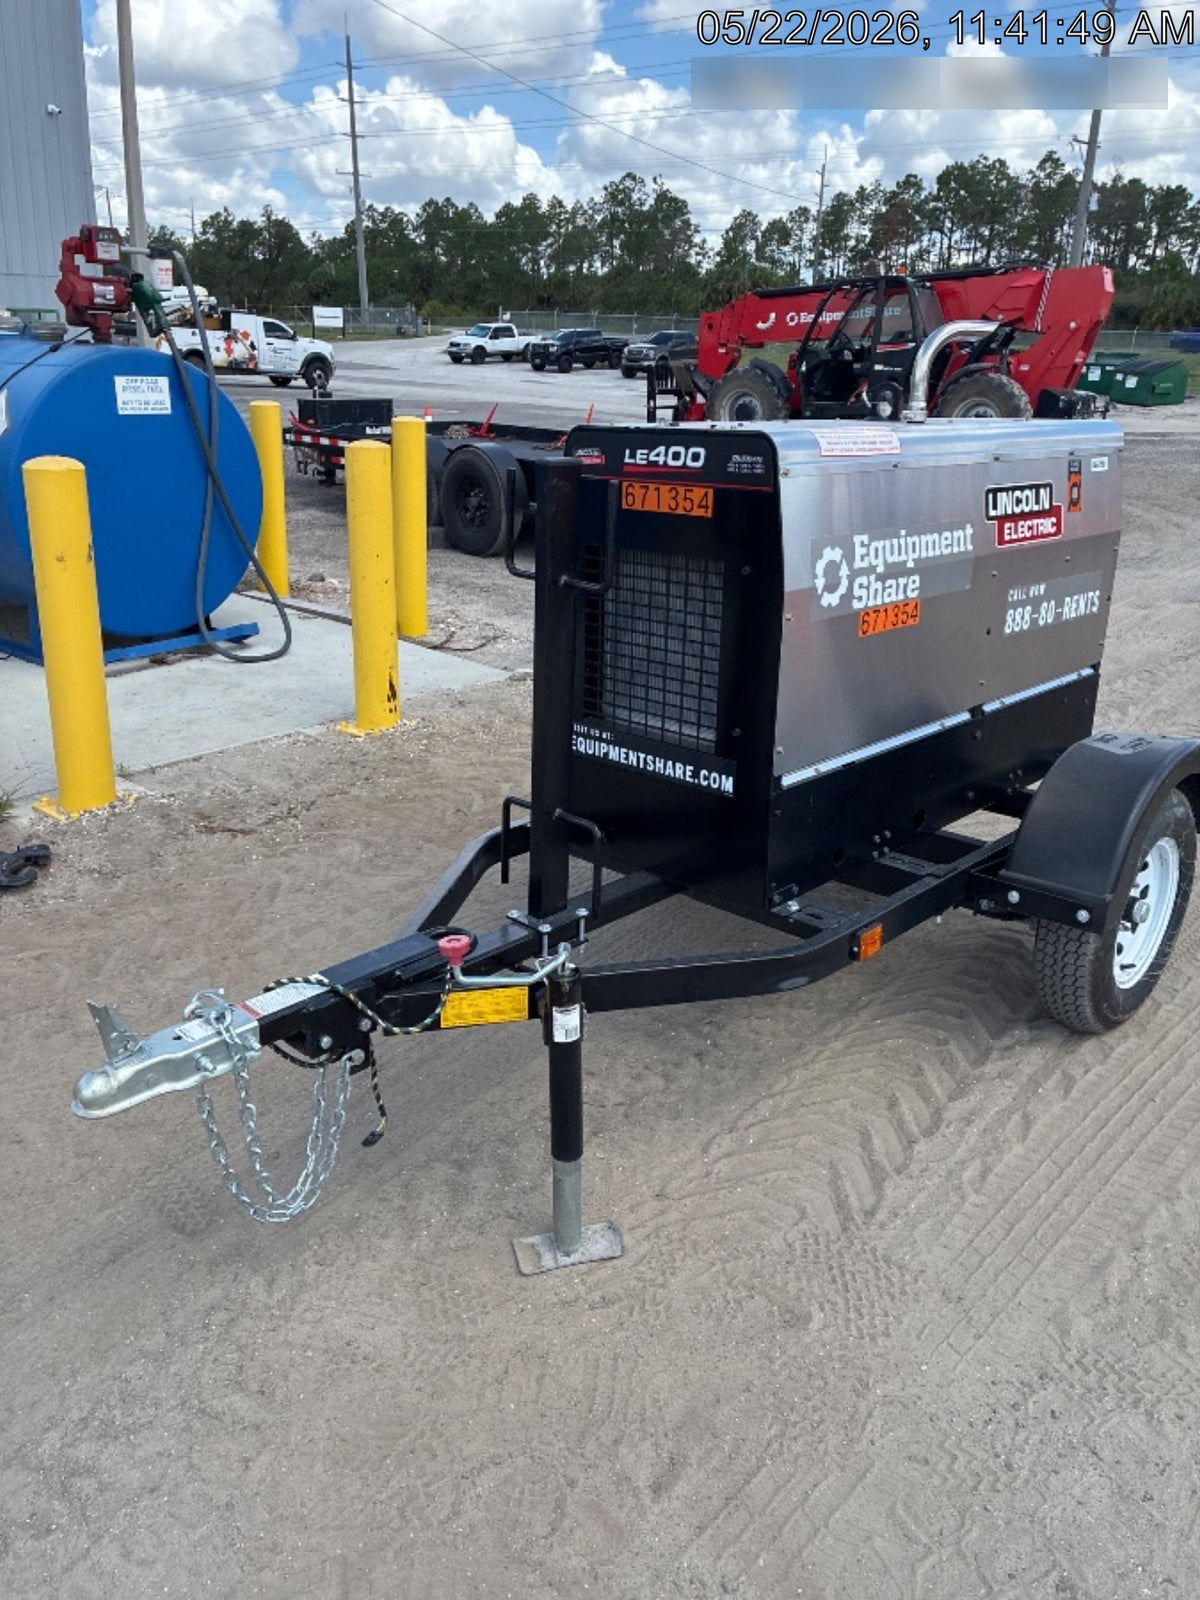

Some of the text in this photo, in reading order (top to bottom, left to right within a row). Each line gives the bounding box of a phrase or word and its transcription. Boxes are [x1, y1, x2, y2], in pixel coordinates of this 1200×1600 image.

[624, 445, 706, 468] LE400
[625, 483, 710, 514] 671354
[988, 487, 1050, 516] LINCOLN
[1004, 517, 1057, 541] ELECTRIC
[852, 524, 974, 573] Equipment
[852, 574, 920, 609] Share
[861, 601, 919, 635] 671354
[1003, 590, 1100, 634] 888-80-RENTS
